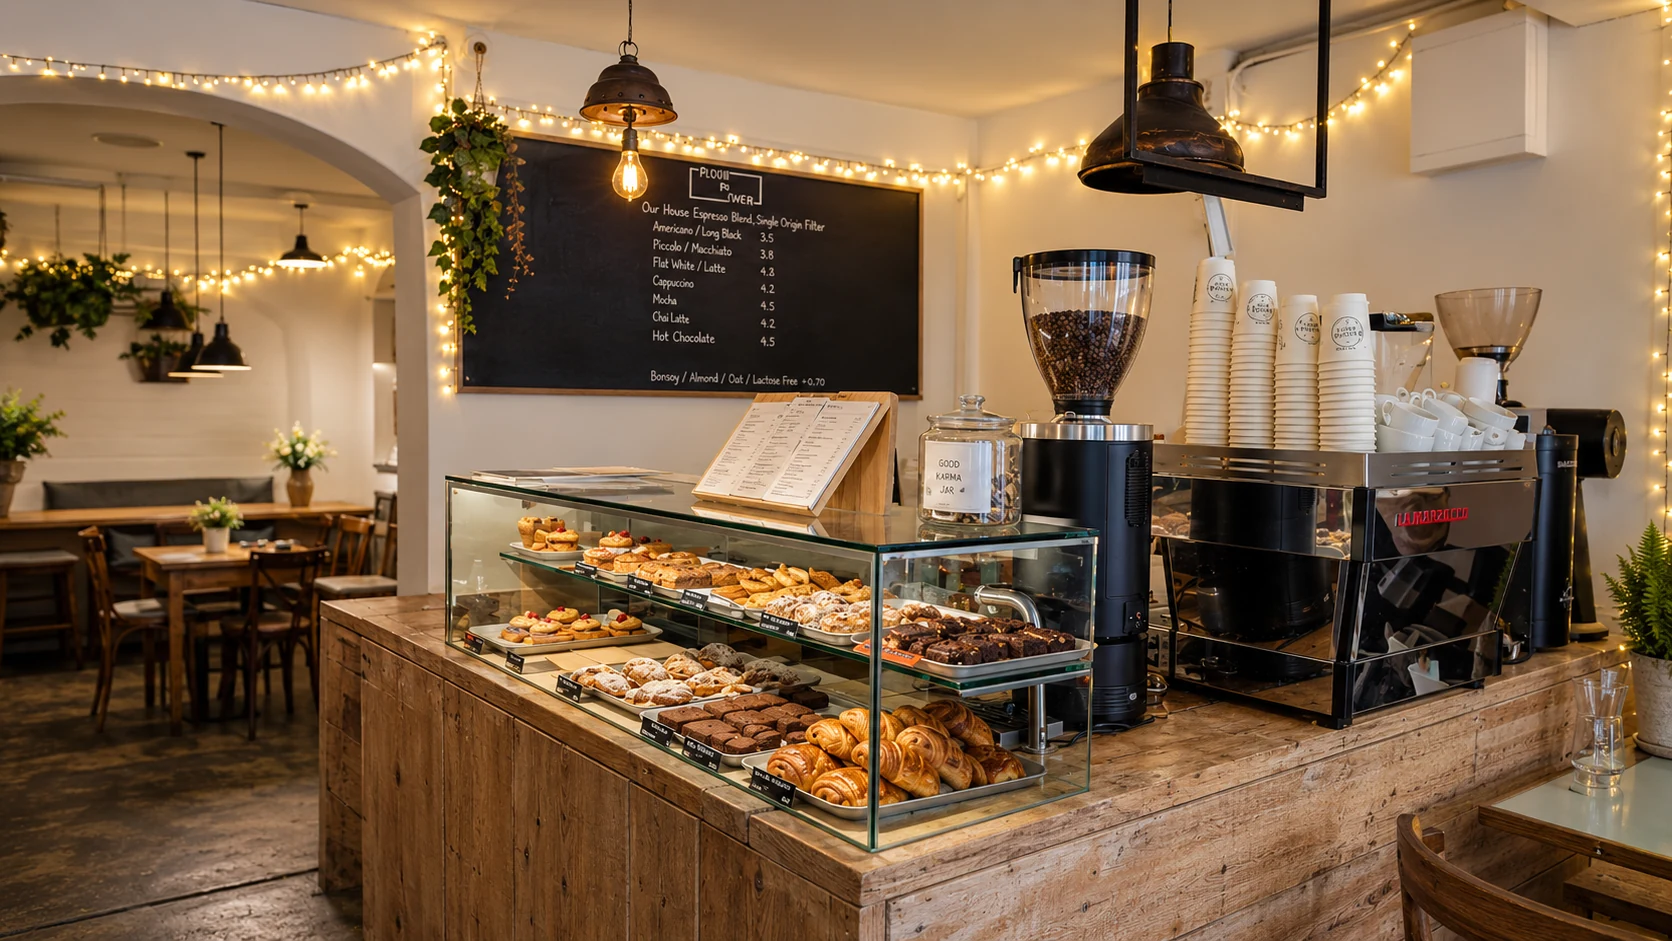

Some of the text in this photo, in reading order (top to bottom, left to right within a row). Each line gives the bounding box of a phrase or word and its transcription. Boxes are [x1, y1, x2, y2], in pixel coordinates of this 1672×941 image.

[641, 201, 660, 214] Our
[663, 203, 690, 218] House
[693, 206, 729, 223] Espresso
[756, 214, 779, 230] Single
[780, 217, 803, 232] Origin
[804, 219, 826, 232] Filter
[652, 220, 694, 235] Americano
[701, 226, 720, 241] Long
[721, 227, 742, 240] Black
[760, 232, 774, 243] 3.5
[653, 238, 682, 252] Piccolo
[691, 242, 733, 257] Macchiato
[760, 249, 774, 260] 3.8
[653, 256, 669, 269] Flat
[671, 258, 695, 271] White
[703, 260, 726, 274] Latte
[760, 283, 776, 294] 4.2
[652, 293, 776, 312] Mocha 4.5
[652, 310, 776, 329] Chai Latte 4.2
[652, 329, 776, 347] Hot Chocolate 4.5
[650, 369, 680, 386] Bonsoy
[689, 371, 719, 383] Almond
[728, 373, 744, 384] Oat
[752, 374, 781, 386] Lactose
[782, 375, 799, 386] Free
[801, 377, 826, 387] +0.70
[938, 458, 960, 469] GOOD
[935, 471, 962, 482] KARMA
[939, 485, 955, 495] JAR
